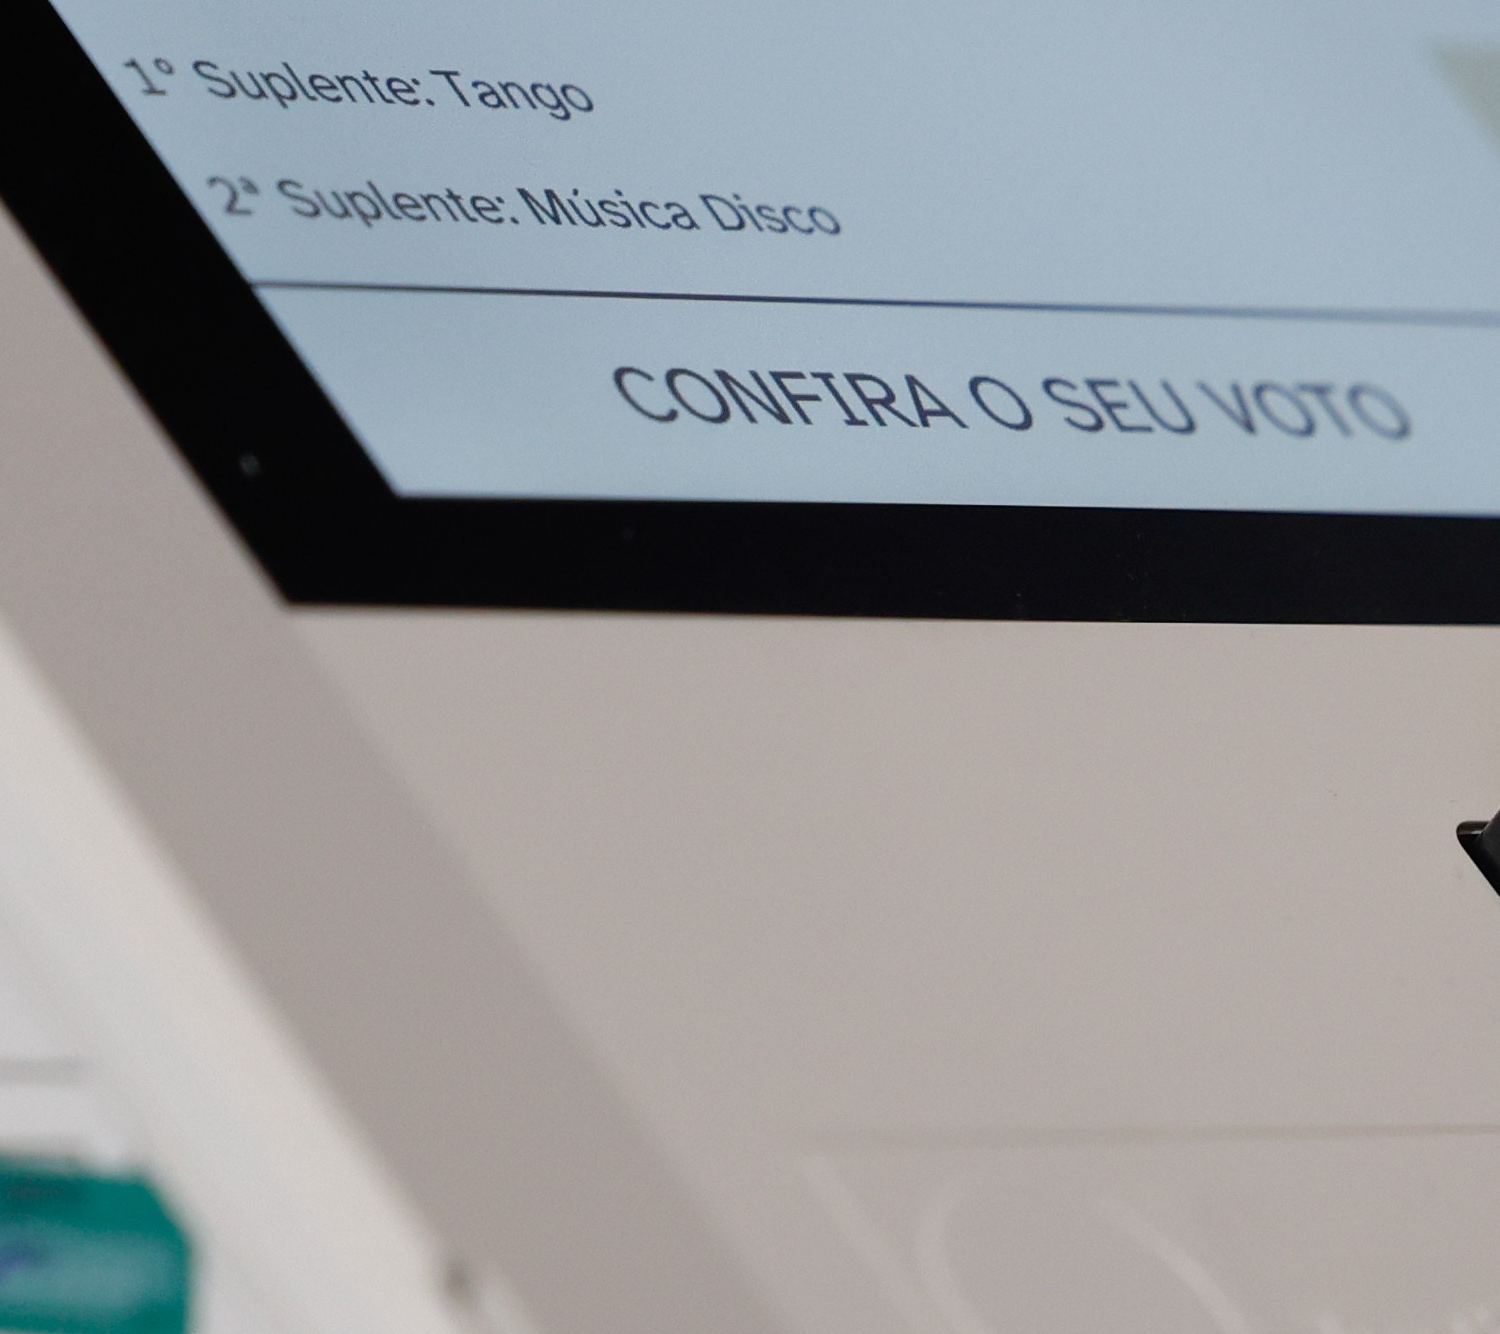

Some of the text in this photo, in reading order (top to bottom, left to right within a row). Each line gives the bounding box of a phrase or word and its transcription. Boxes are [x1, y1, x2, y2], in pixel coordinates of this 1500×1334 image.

[192, 60, 435, 109] Suplente:
[432, 69, 595, 121] Tango
[277, 178, 518, 229] Suplente:
[516, 186, 700, 233] Música
[698, 194, 842, 237] Disco
[613, 366, 1414, 441] CONFIRA O SEU VOTO
